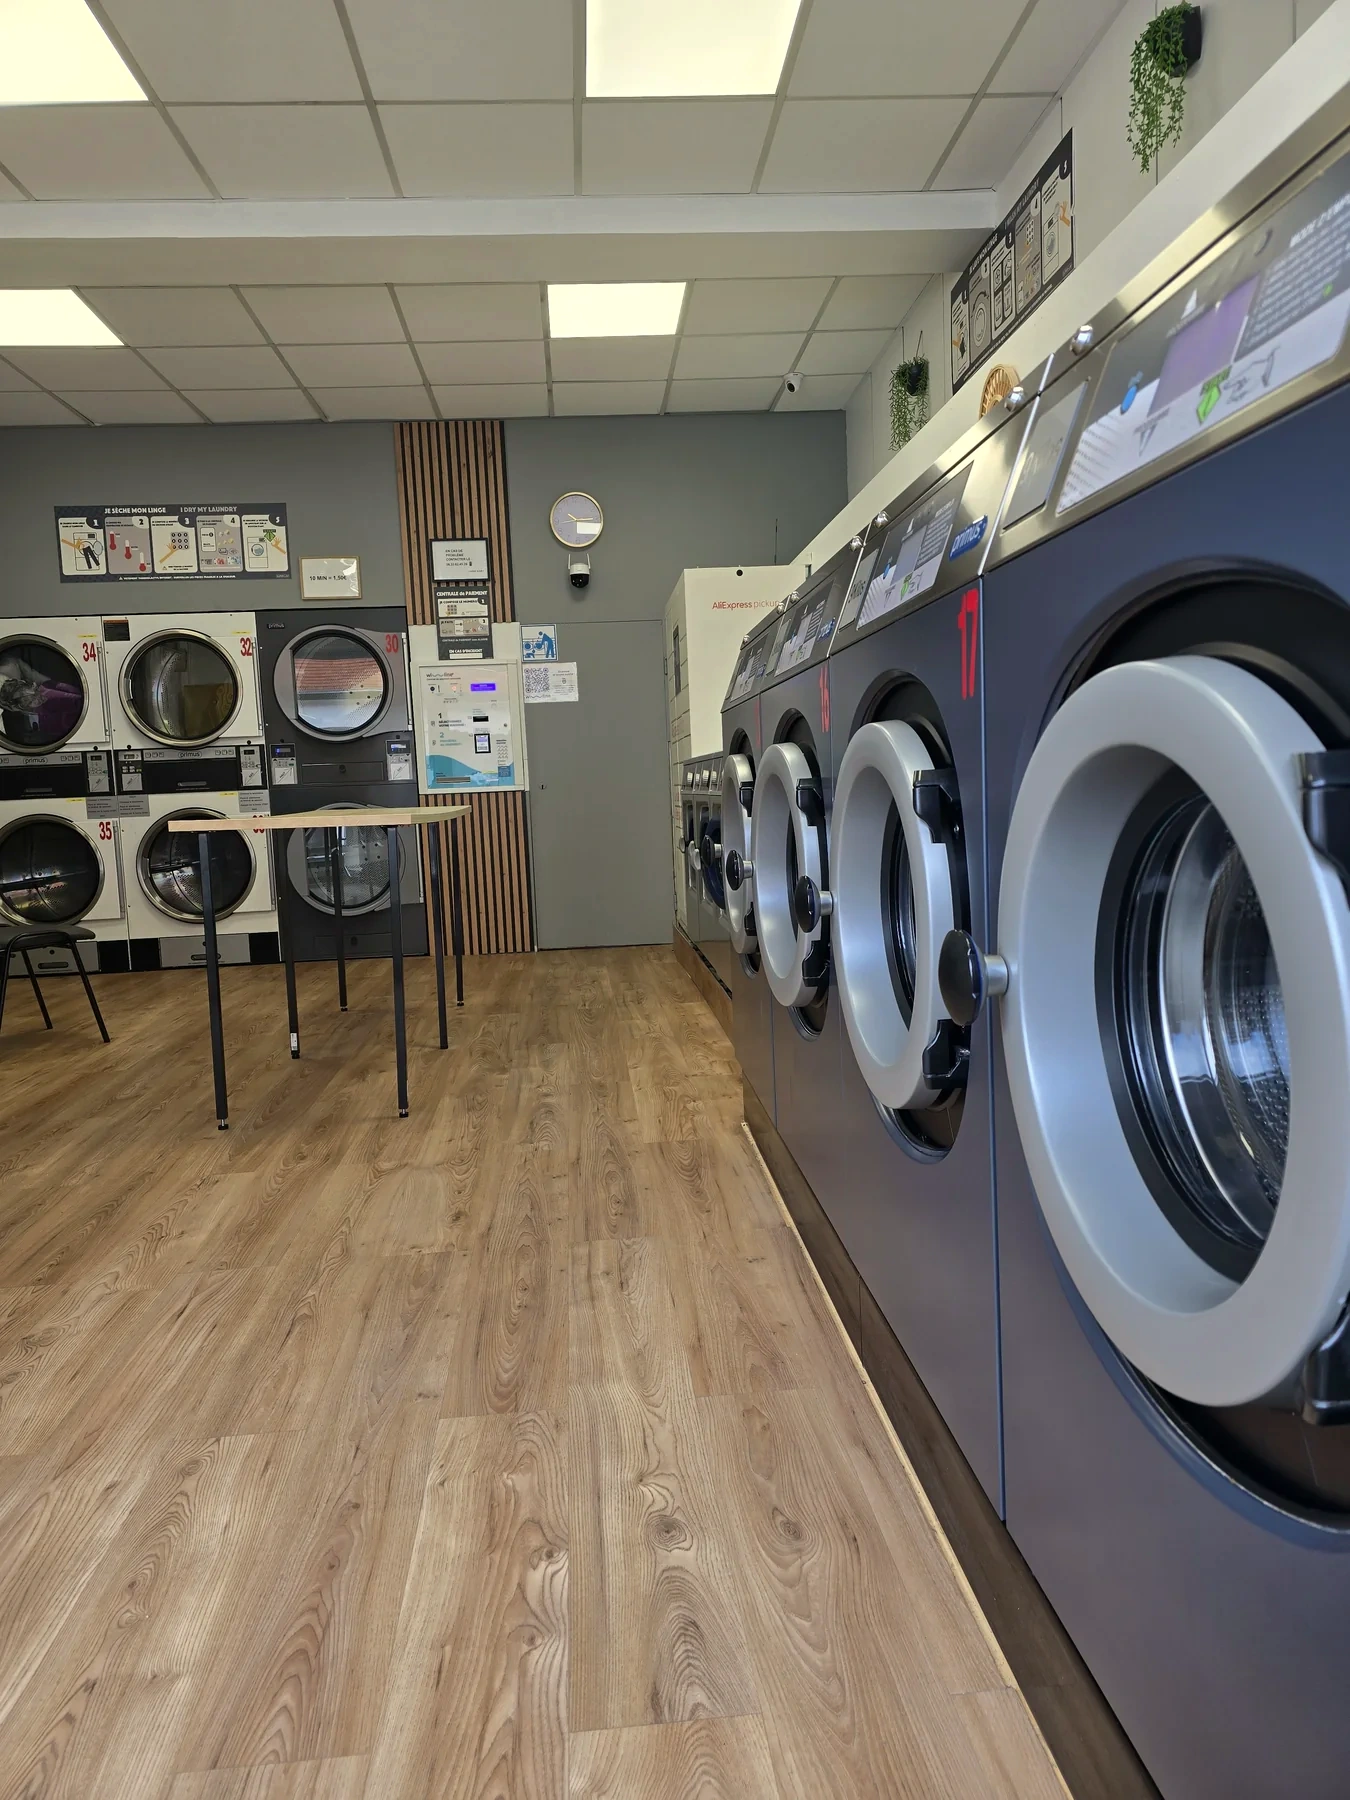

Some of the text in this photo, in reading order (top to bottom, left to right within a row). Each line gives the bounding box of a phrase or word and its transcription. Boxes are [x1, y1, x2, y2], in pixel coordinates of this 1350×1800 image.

[712, 602, 752, 610] AliExpress
[82, 642, 96, 661] 34
[240, 638, 252, 656] 32
[385, 634, 398, 653] 30
[958, 588, 979, 700] 17
[99, 821, 112, 840] 35
